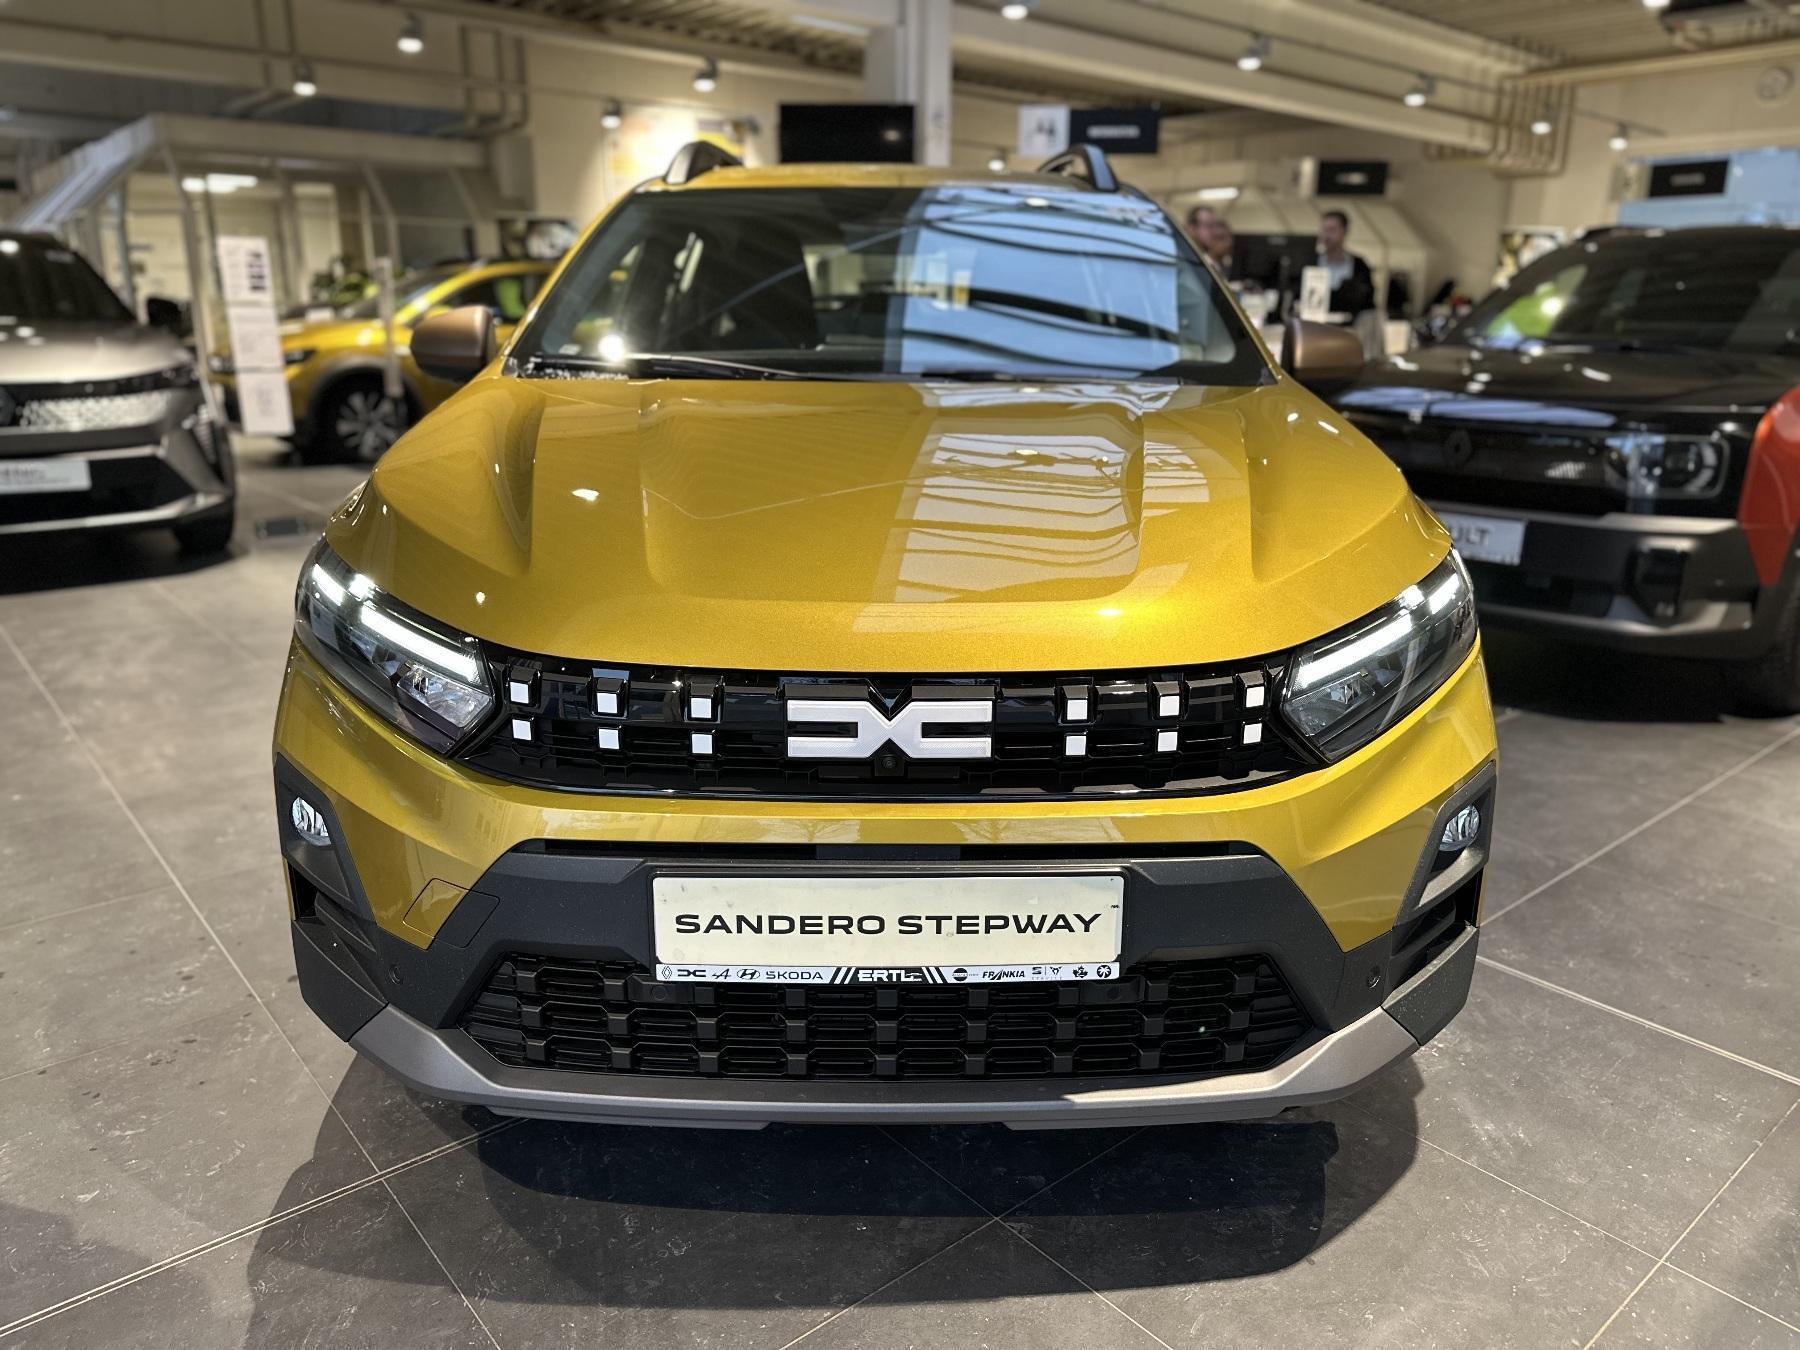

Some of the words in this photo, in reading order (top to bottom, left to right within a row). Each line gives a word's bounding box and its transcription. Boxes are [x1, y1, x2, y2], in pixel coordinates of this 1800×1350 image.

[675, 913, 886, 936] SANDERO
[897, 913, 1102, 935] STEPWAY
[857, 969, 915, 982] ERTL
[982, 969, 1026, 981] FRANKIA
